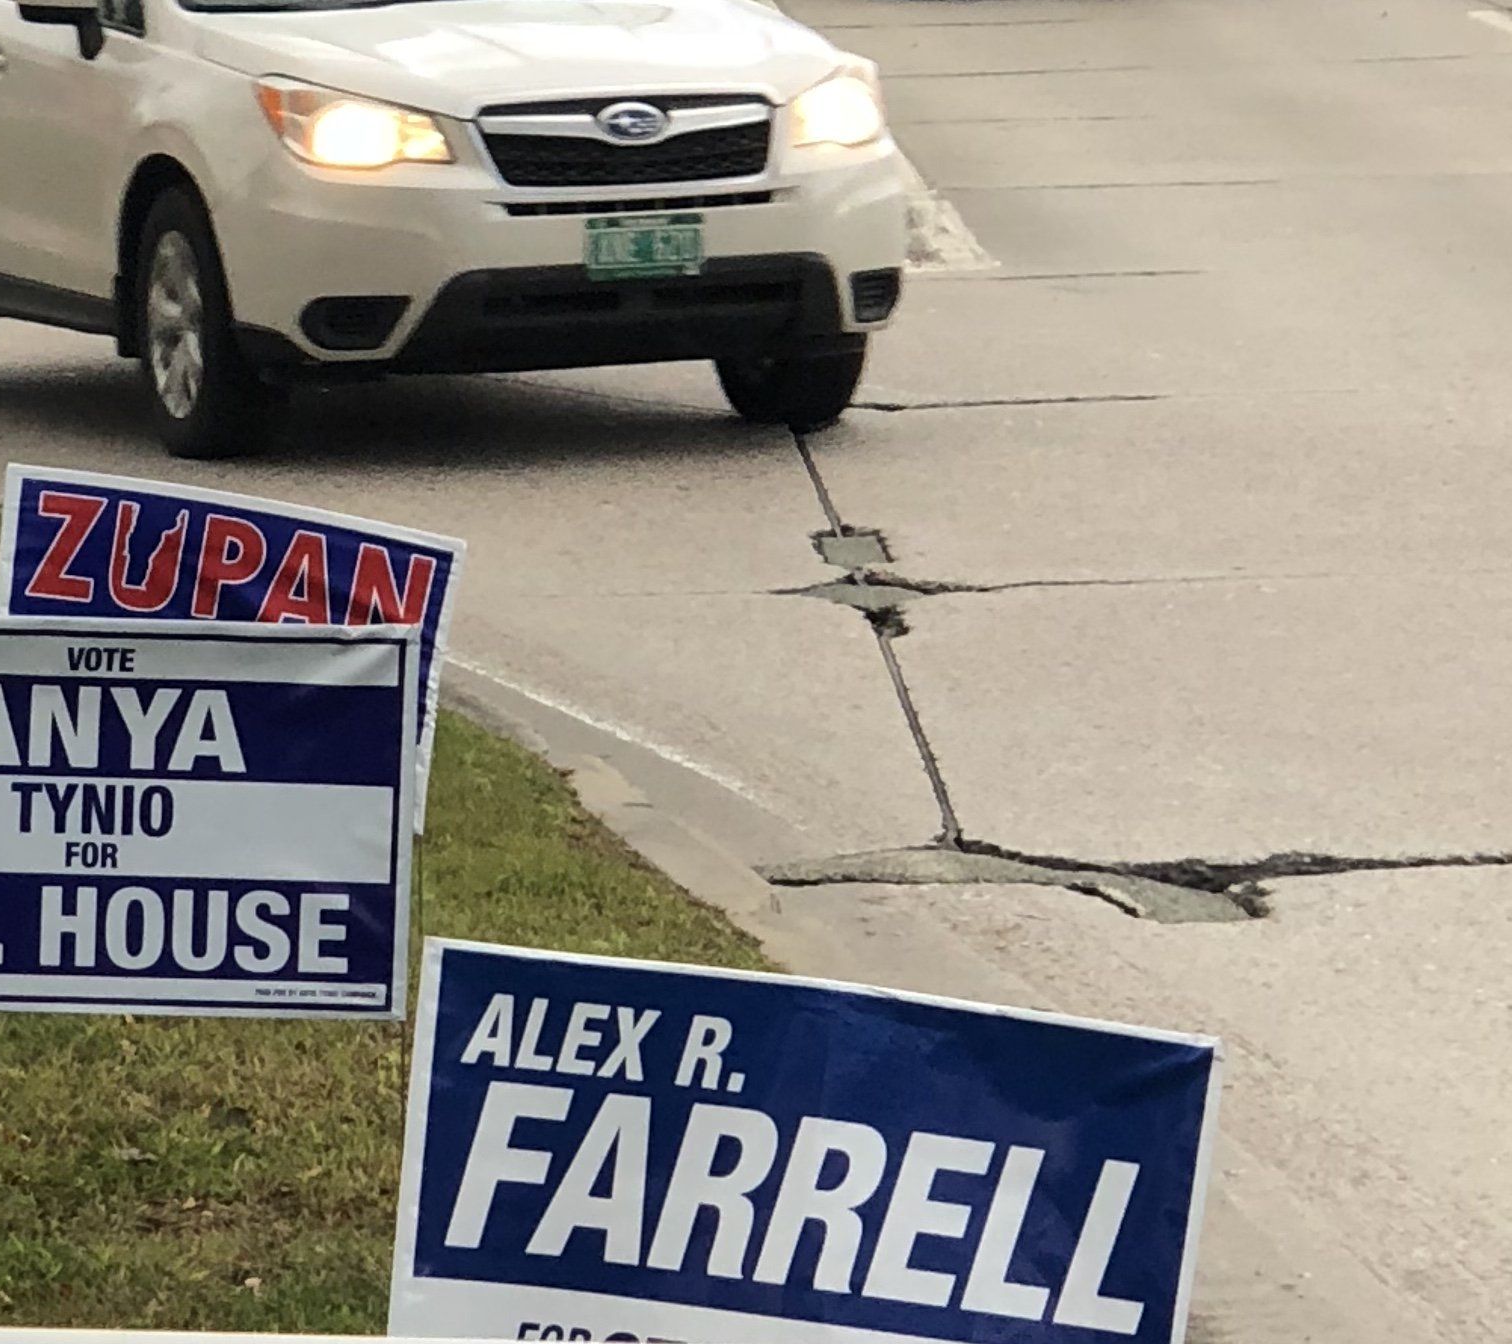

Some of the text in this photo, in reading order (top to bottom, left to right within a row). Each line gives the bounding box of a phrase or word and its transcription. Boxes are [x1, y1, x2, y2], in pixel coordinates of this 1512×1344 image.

[24, 490, 437, 626] ZUPAN
[67, 646, 136, 674] VOTE
[11, 782, 174, 837] TYNIO
[65, 842, 118, 869] FOR
[38, 885, 350, 974] HOUSE
[461, 993, 745, 1093] ALEX R.
[444, 1082, 1146, 1337] FARRELL
